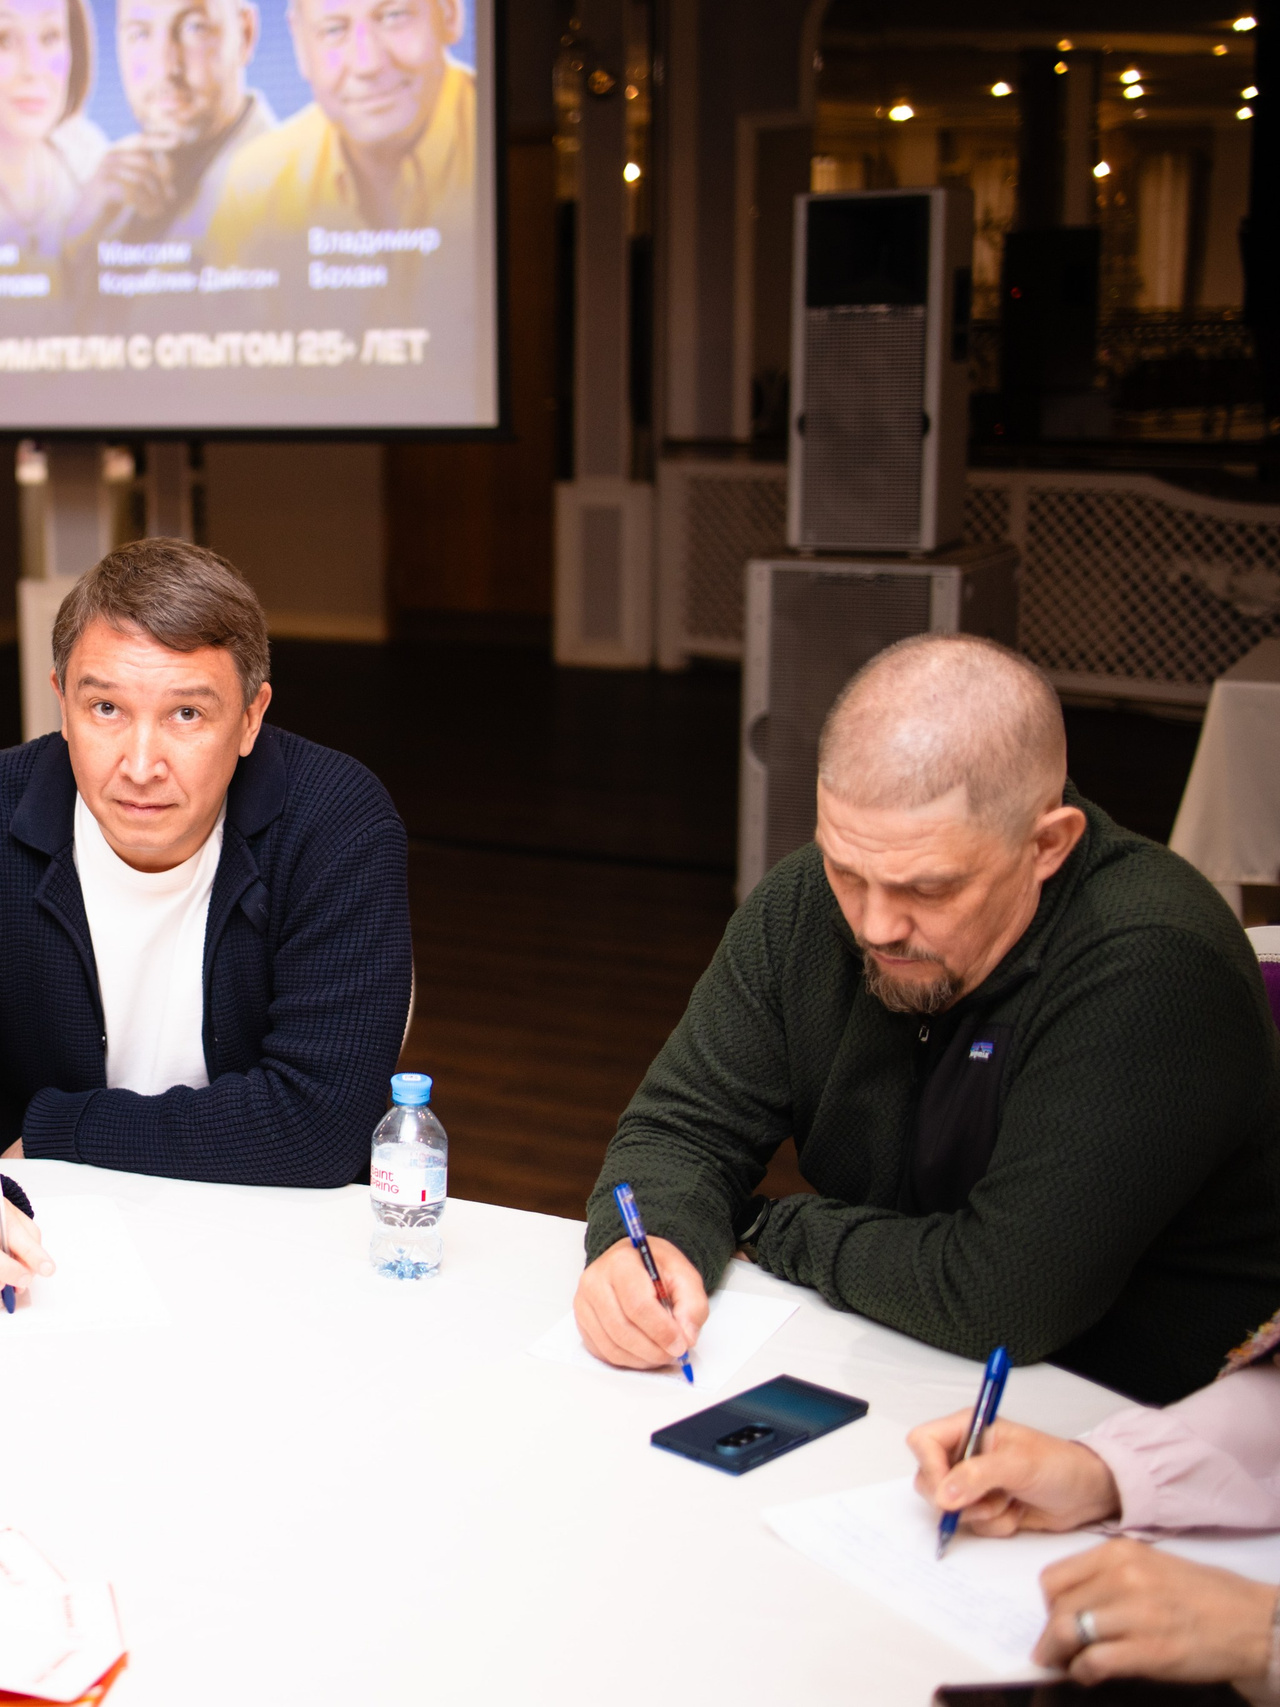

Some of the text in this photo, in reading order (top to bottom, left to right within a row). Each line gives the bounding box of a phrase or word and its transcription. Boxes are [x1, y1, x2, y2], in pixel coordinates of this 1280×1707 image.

[98, 241, 191, 266] Максим
[307, 225, 441, 256] Владимир
[126, 333, 153, 370] С
[154, 330, 295, 369] ОПЫТОМ
[359, 328, 430, 366] ЛЕТ
